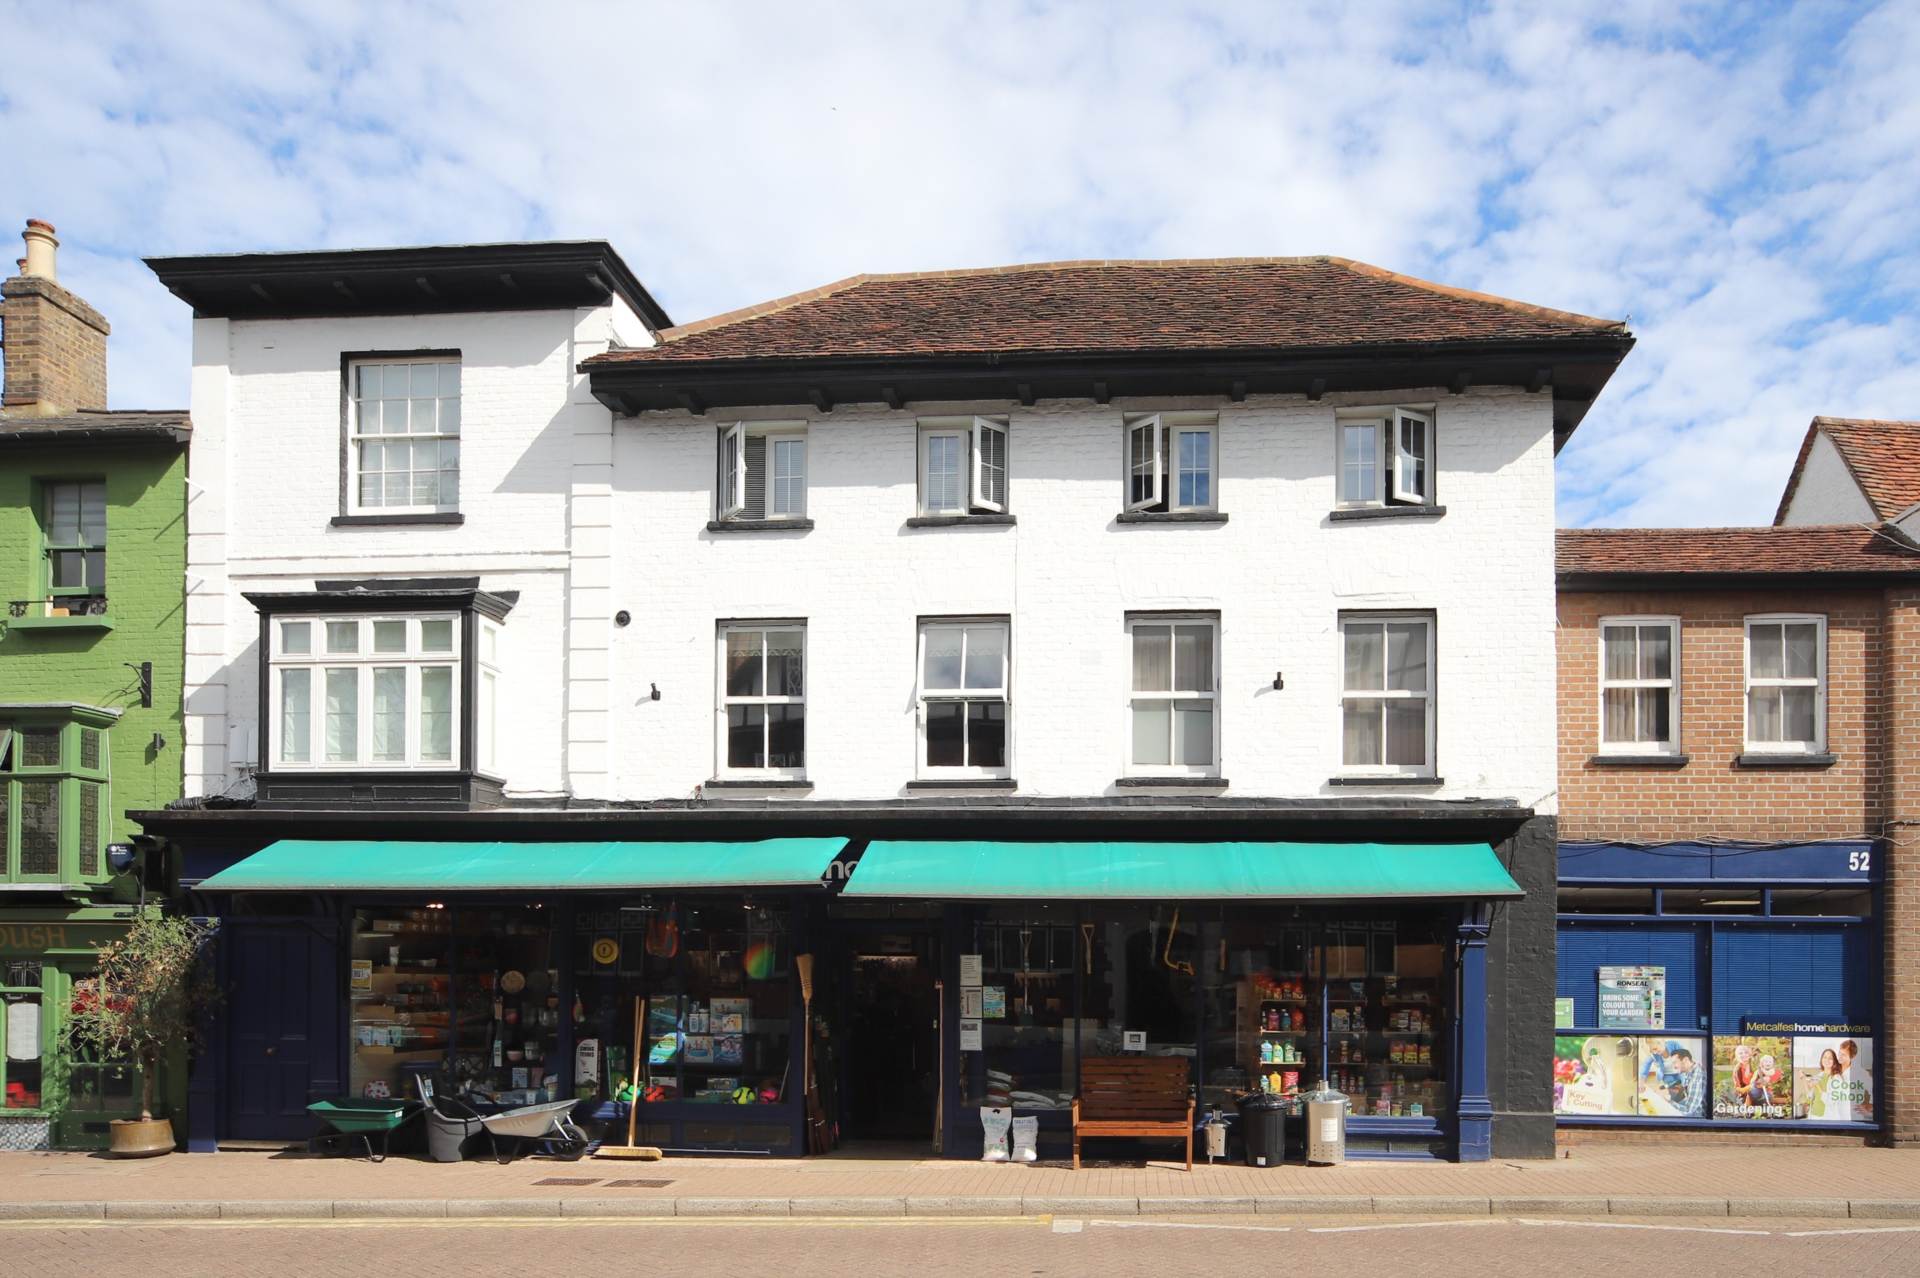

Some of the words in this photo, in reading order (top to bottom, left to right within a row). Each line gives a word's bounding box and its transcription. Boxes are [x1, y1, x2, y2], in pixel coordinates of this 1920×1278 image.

[1849, 851, 1870, 871] 52
[1622, 994, 1640, 1002] SOME
[1830, 1079, 1864, 1090] Cook
[1568, 1089, 1585, 1101] Key
[1830, 1091, 1864, 1103] Shop
[1573, 1099, 1603, 1111] Cutting
[1716, 1102, 1784, 1117] Gardening
